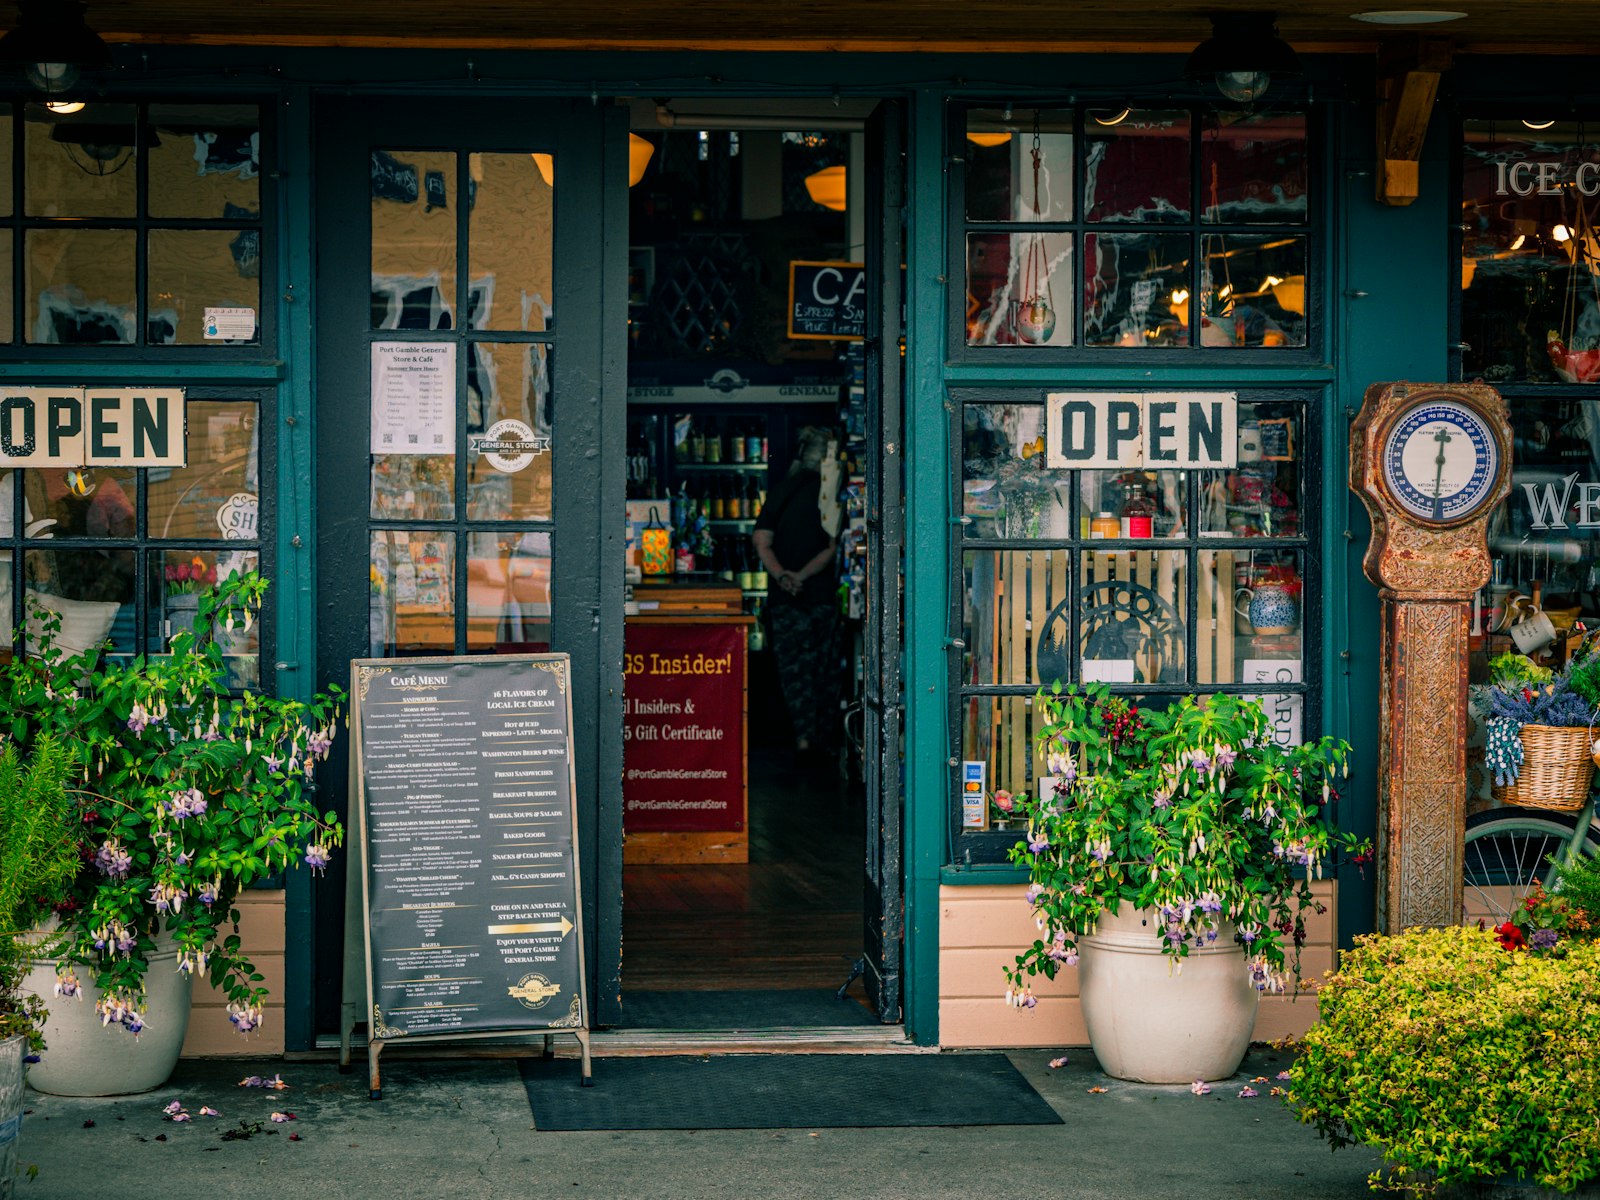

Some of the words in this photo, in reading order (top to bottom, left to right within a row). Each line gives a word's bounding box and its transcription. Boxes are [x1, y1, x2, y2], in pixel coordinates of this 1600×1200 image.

[1496, 162, 1564, 196] ICE
[634, 388, 674, 396] STORE
[779, 386, 836, 396] GENERAL
[1, 397, 168, 457] OPEN
[1061, 400, 1222, 461] OPEN
[650, 654, 731, 675] Insider!
[391, 675, 417, 686] CAFÉ
[418, 676, 448, 685] MENU
[634, 698, 681, 714] Insiders
[684, 699, 695, 714] &
[635, 725, 658, 740] Gift
[661, 724, 723, 740] Certificate
[628, 769, 727, 780] @PortGambleGeneralStore
[628, 799, 727, 810] @PortGambleGeneralStore
